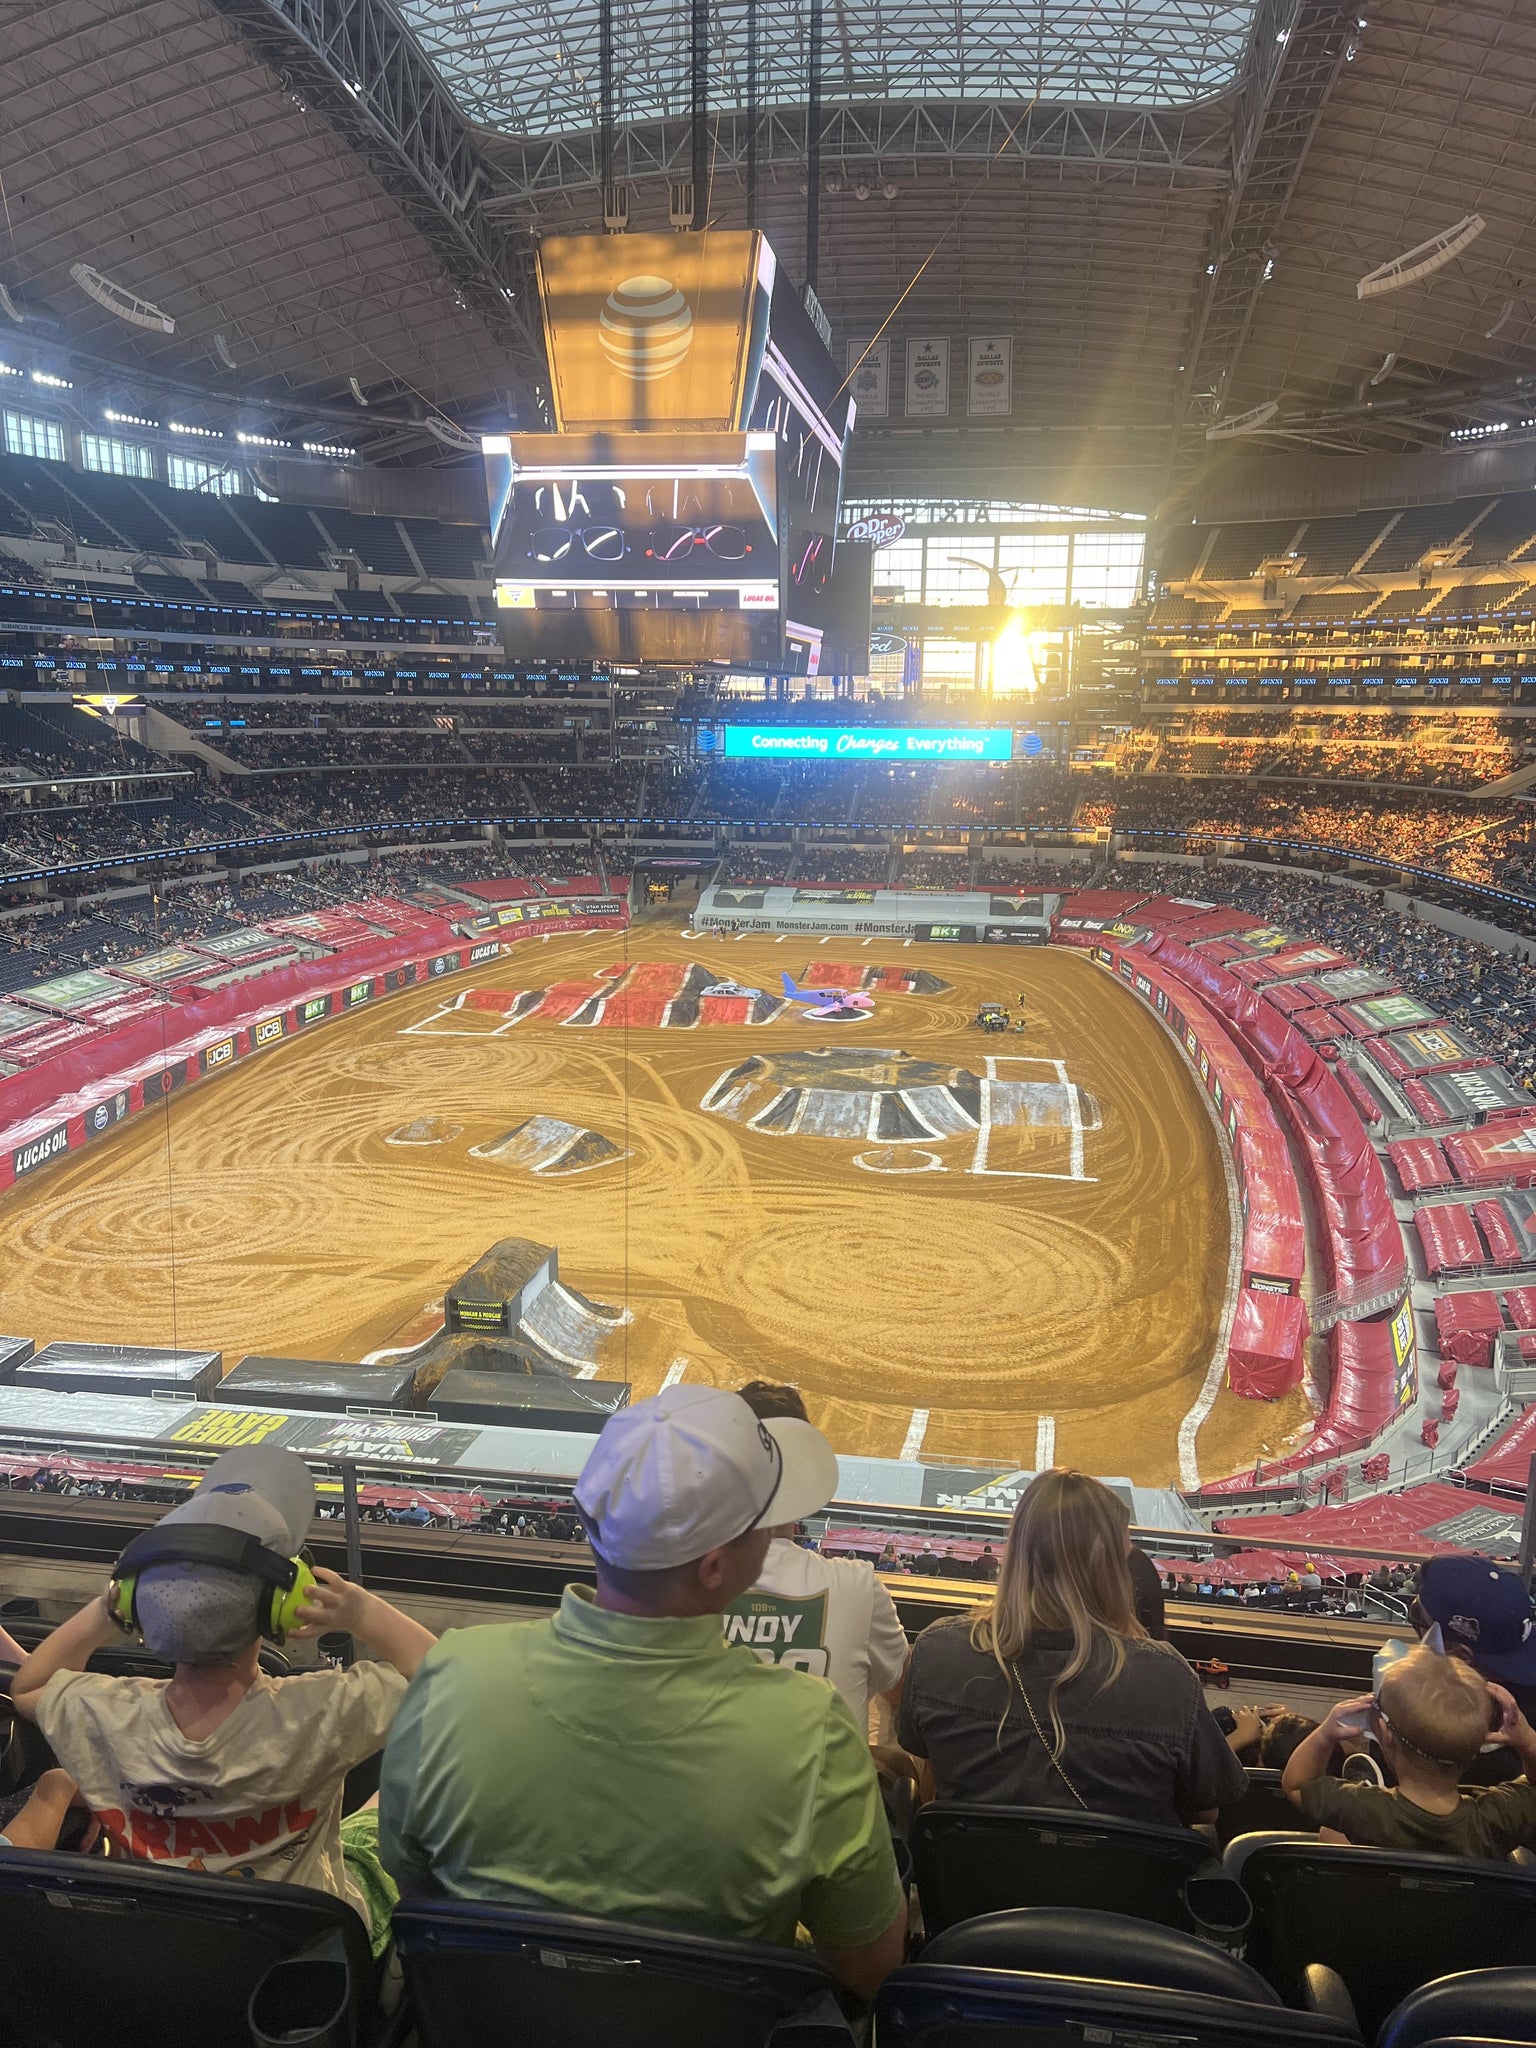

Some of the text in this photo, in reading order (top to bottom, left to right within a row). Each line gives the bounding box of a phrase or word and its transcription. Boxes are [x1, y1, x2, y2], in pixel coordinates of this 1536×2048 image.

[867, 518, 889, 534] Dr
[751, 734, 985, 754] Connecting Changes Everything
[776, 920, 849, 932] MonsterJam.com
[854, 922, 916, 935] #MonsterJa
[930, 926, 959, 937] BKT
[207, 936, 248, 952] LUCAS
[471, 945, 490, 961] LUCAS
[350, 983, 369, 999] BKT
[305, 999, 326, 1018] BKT
[1374, 998, 1427, 1021] BKT
[258, 1021, 280, 1041] JCB
[209, 1043, 232, 1066] JCB
[1450, 1071, 1496, 1097] LUCAS
[16, 1128, 68, 1173] LUCAS OIL
[198, 1409, 289, 1433] GAME
[170, 1425, 269, 1447] VIDEO
[751, 1603, 777, 1612] 109TH
